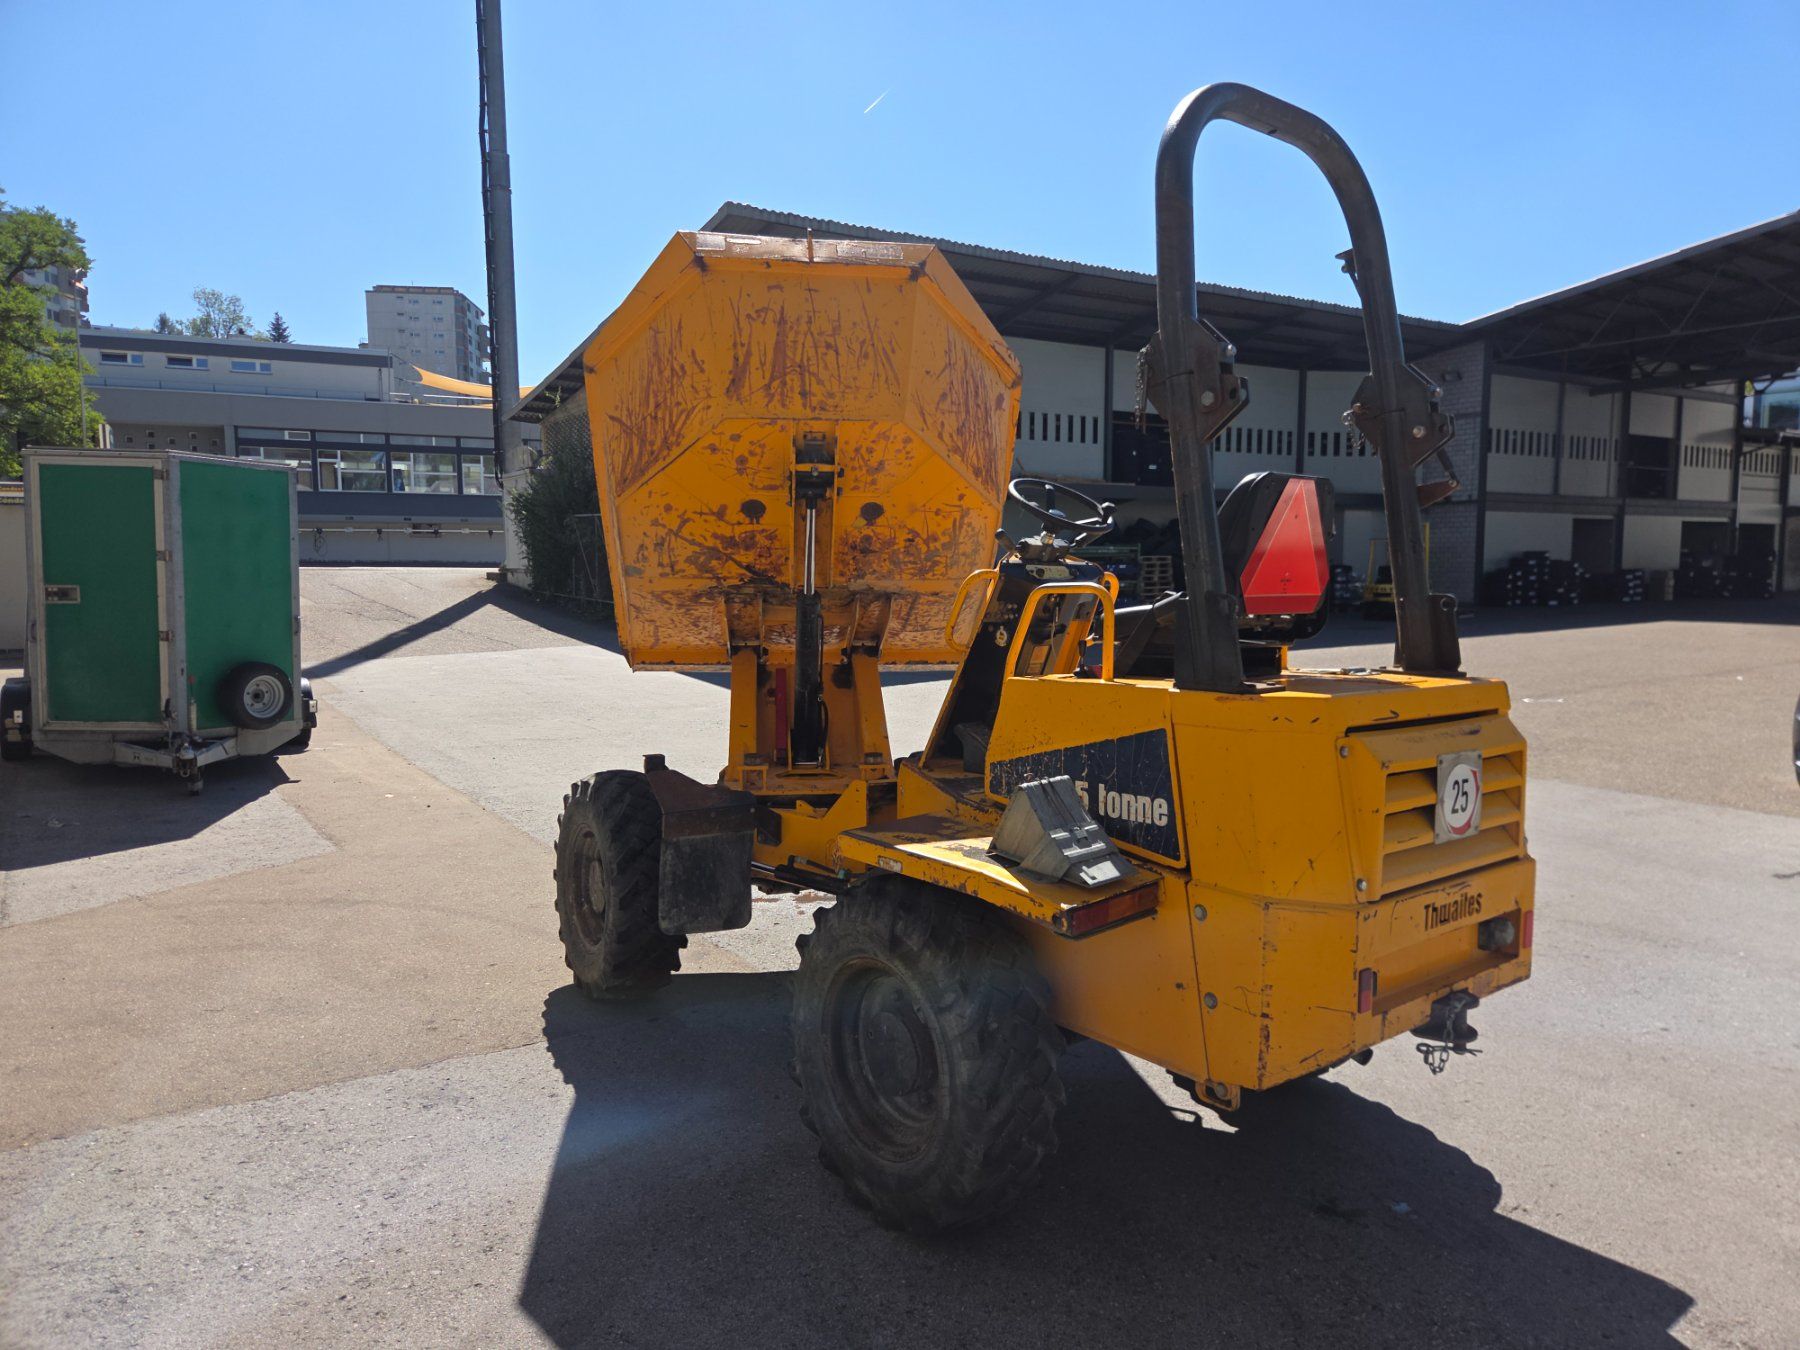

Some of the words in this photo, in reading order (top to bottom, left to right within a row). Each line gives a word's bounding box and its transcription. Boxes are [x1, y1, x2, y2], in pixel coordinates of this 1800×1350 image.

[1075, 780, 1089, 812] 5
[1098, 783, 1168, 827] tonne
[1451, 778, 1469, 814] 25
[1424, 892, 1483, 932] Thwaites
